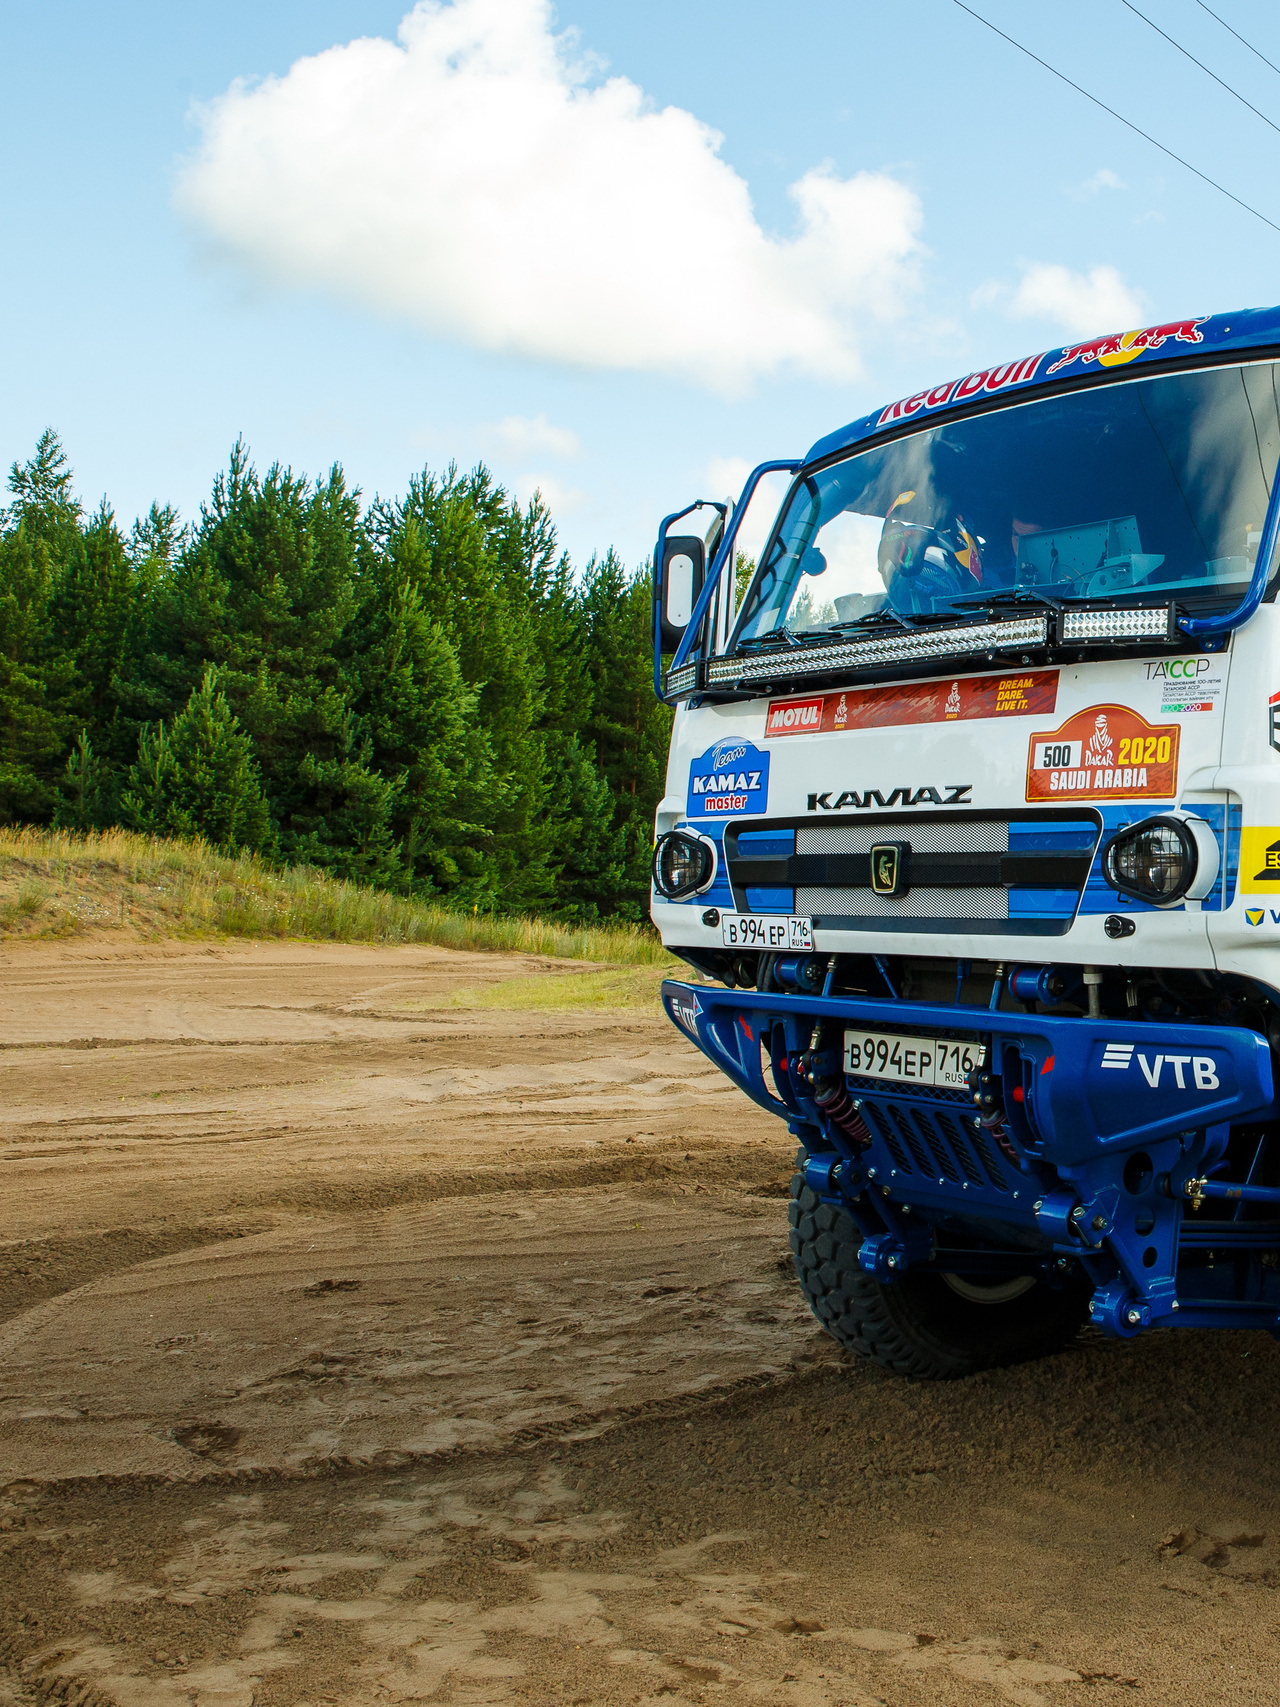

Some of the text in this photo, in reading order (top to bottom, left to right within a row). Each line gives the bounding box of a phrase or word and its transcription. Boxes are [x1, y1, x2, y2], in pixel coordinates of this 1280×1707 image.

[997, 690, 1024, 700] DARE.
[998, 678, 1034, 690] DREAM.
[995, 699, 1028, 711] LIVE IT.
[770, 706, 818, 728] MOTUL
[712, 742, 746, 771] Team
[1043, 745, 1071, 768] 500
[1118, 736, 1171, 766] 2020
[692, 771, 761, 794] KAMAZ
[1050, 768, 1148, 790] SAUDI ARABIA
[705, 793, 747, 811] master
[807, 785, 973, 811] KAMAZ
[791, 921, 808, 936] 716
[938, 1044, 973, 1073] 716
[945, 1072, 963, 1083] RUS
[1137, 1053, 1220, 1090] VTB
